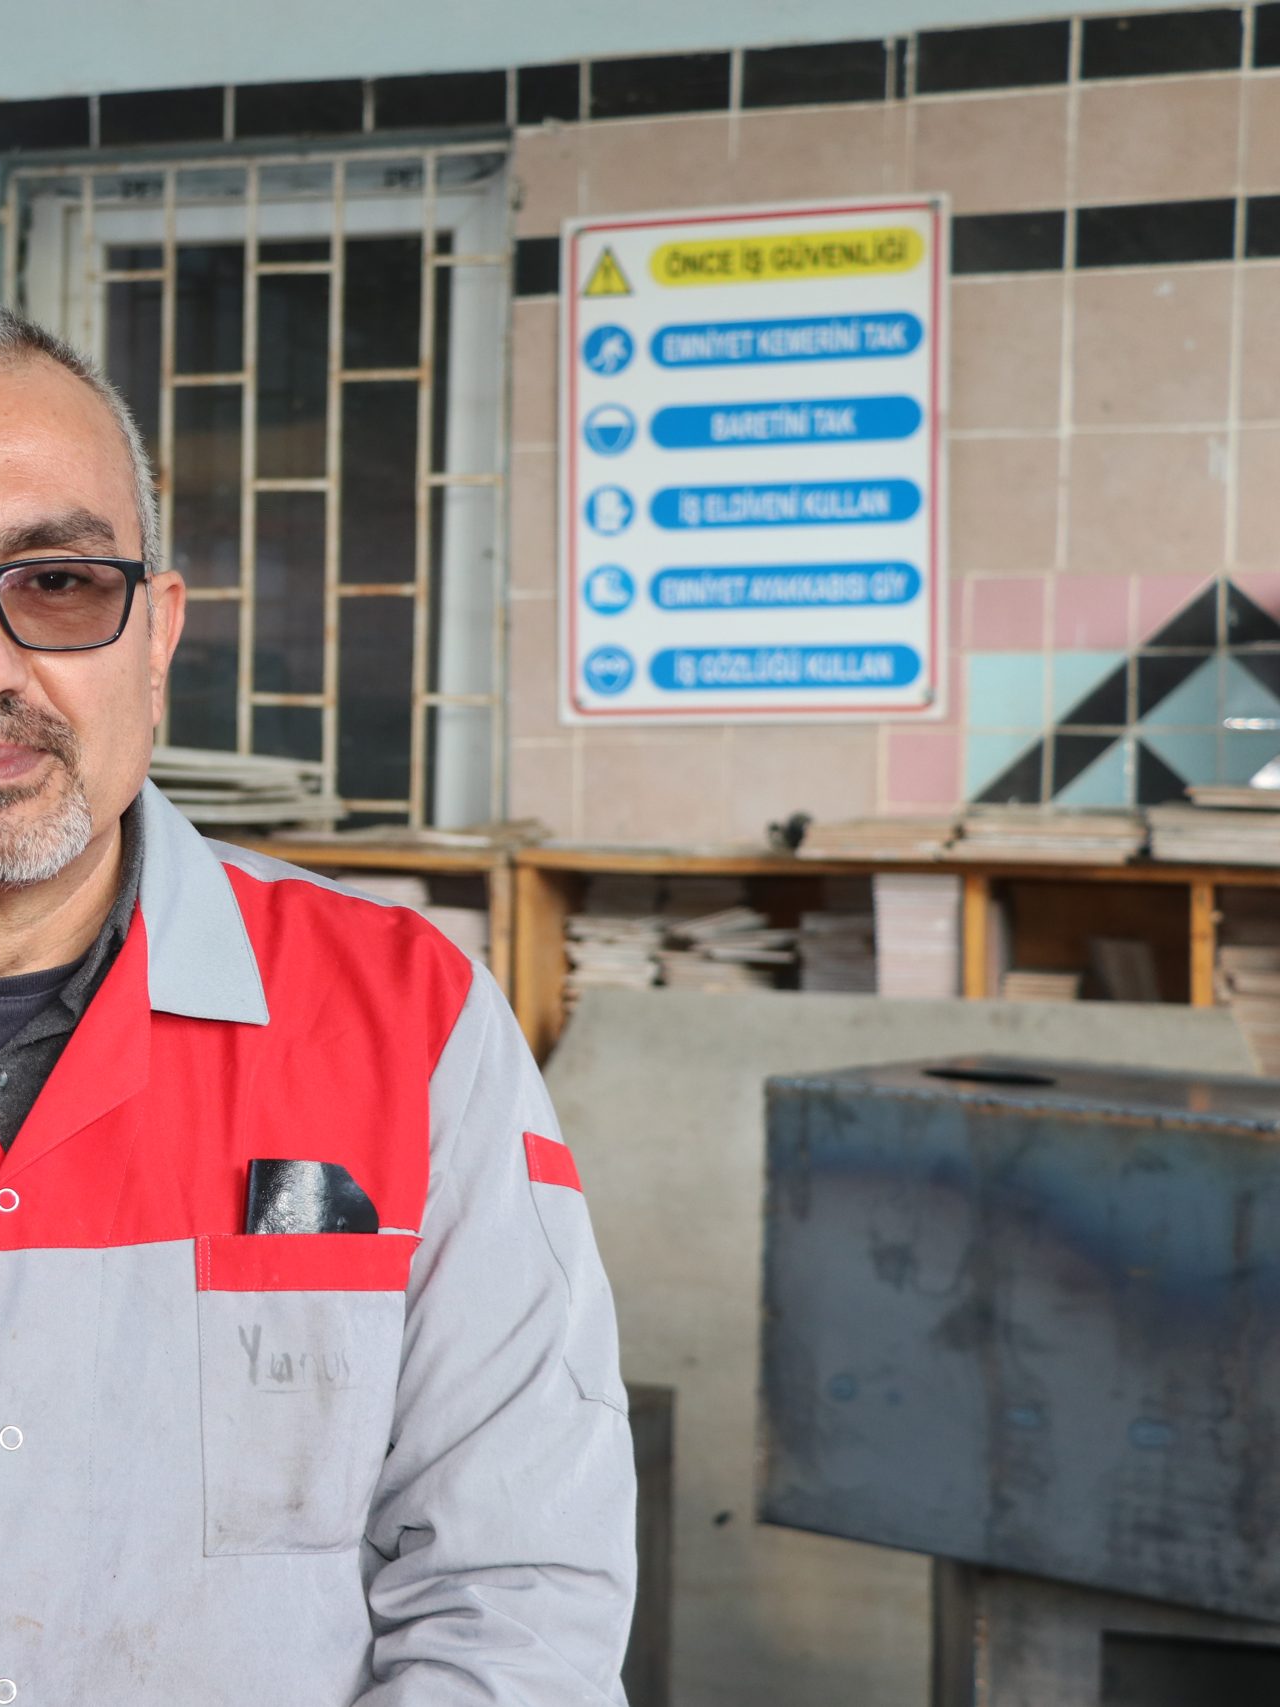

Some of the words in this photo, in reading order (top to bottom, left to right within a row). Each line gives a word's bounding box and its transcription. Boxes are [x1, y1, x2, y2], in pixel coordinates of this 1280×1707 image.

[665, 247, 735, 278] ÖNCE
[863, 321, 907, 349] TAK
[813, 407, 857, 435] TAK
